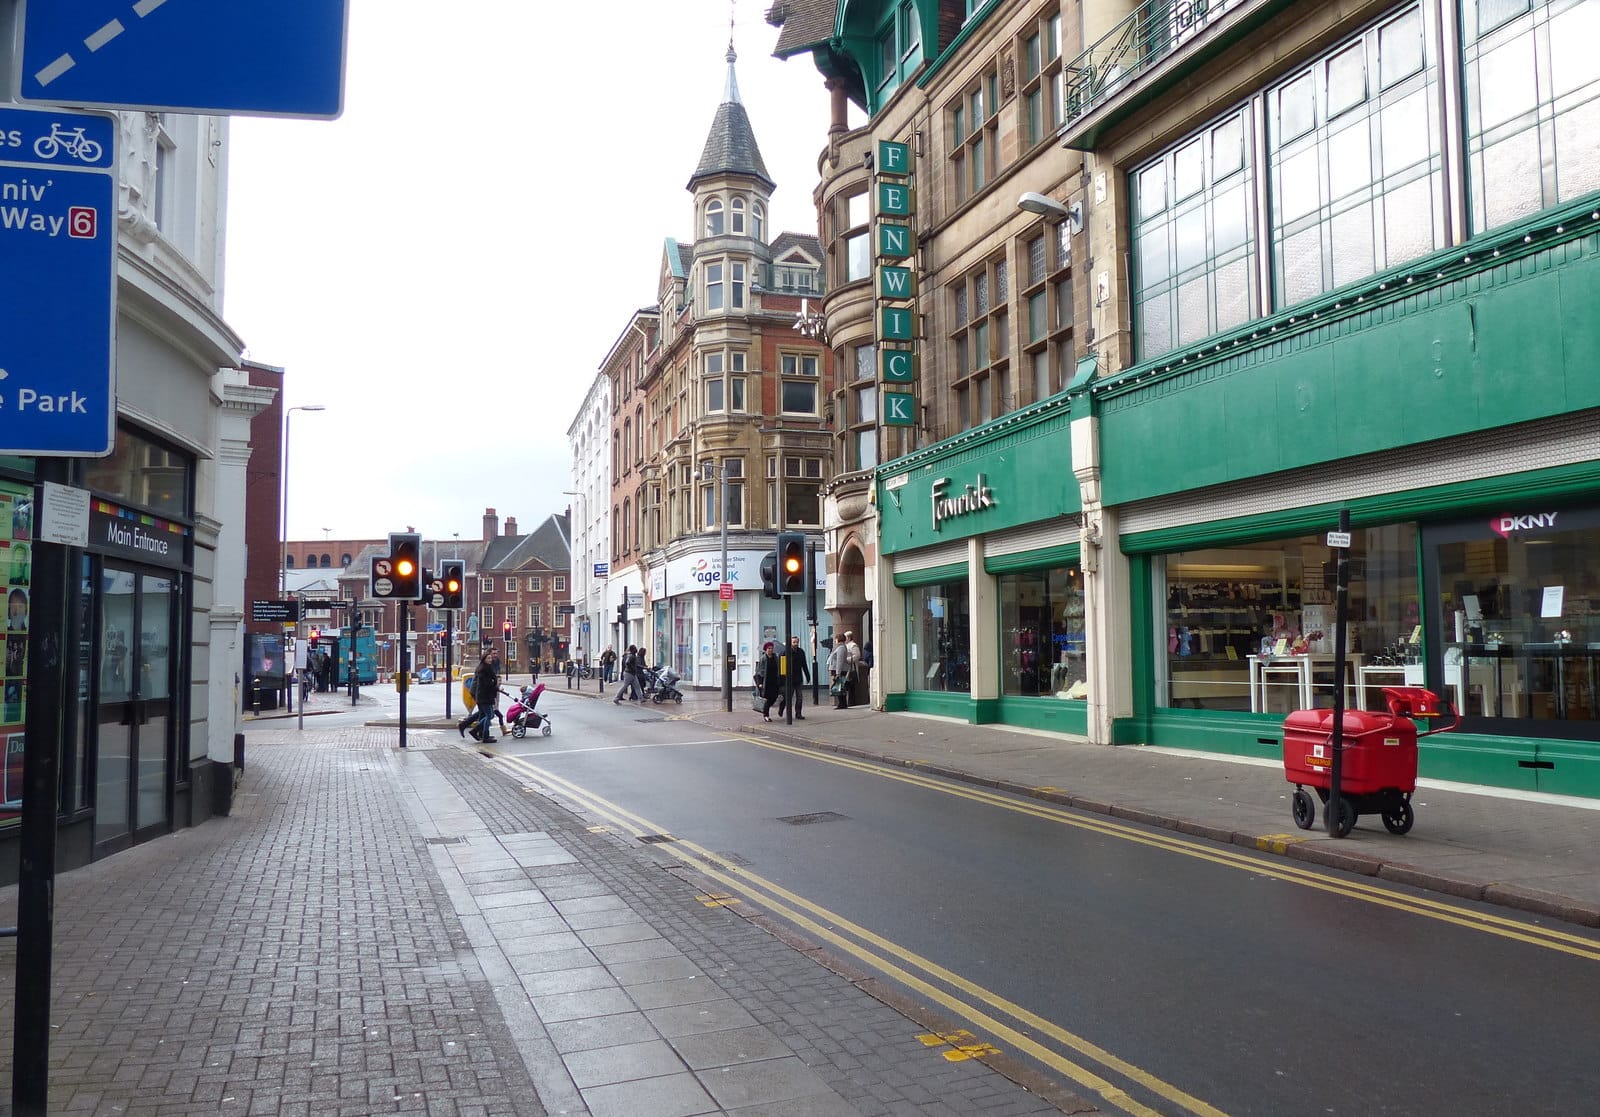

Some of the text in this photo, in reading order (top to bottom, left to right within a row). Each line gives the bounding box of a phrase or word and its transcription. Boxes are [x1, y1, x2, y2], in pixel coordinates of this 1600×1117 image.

[0, 206, 92, 237] Way 6
[885, 147, 909, 420] FENWICK
[18, 388, 88, 414] Park
[1501, 512, 1558, 531] DKNY
[107, 520, 132, 547] Main
[134, 527, 168, 555] Entrance
[697, 571, 721, 586] age
